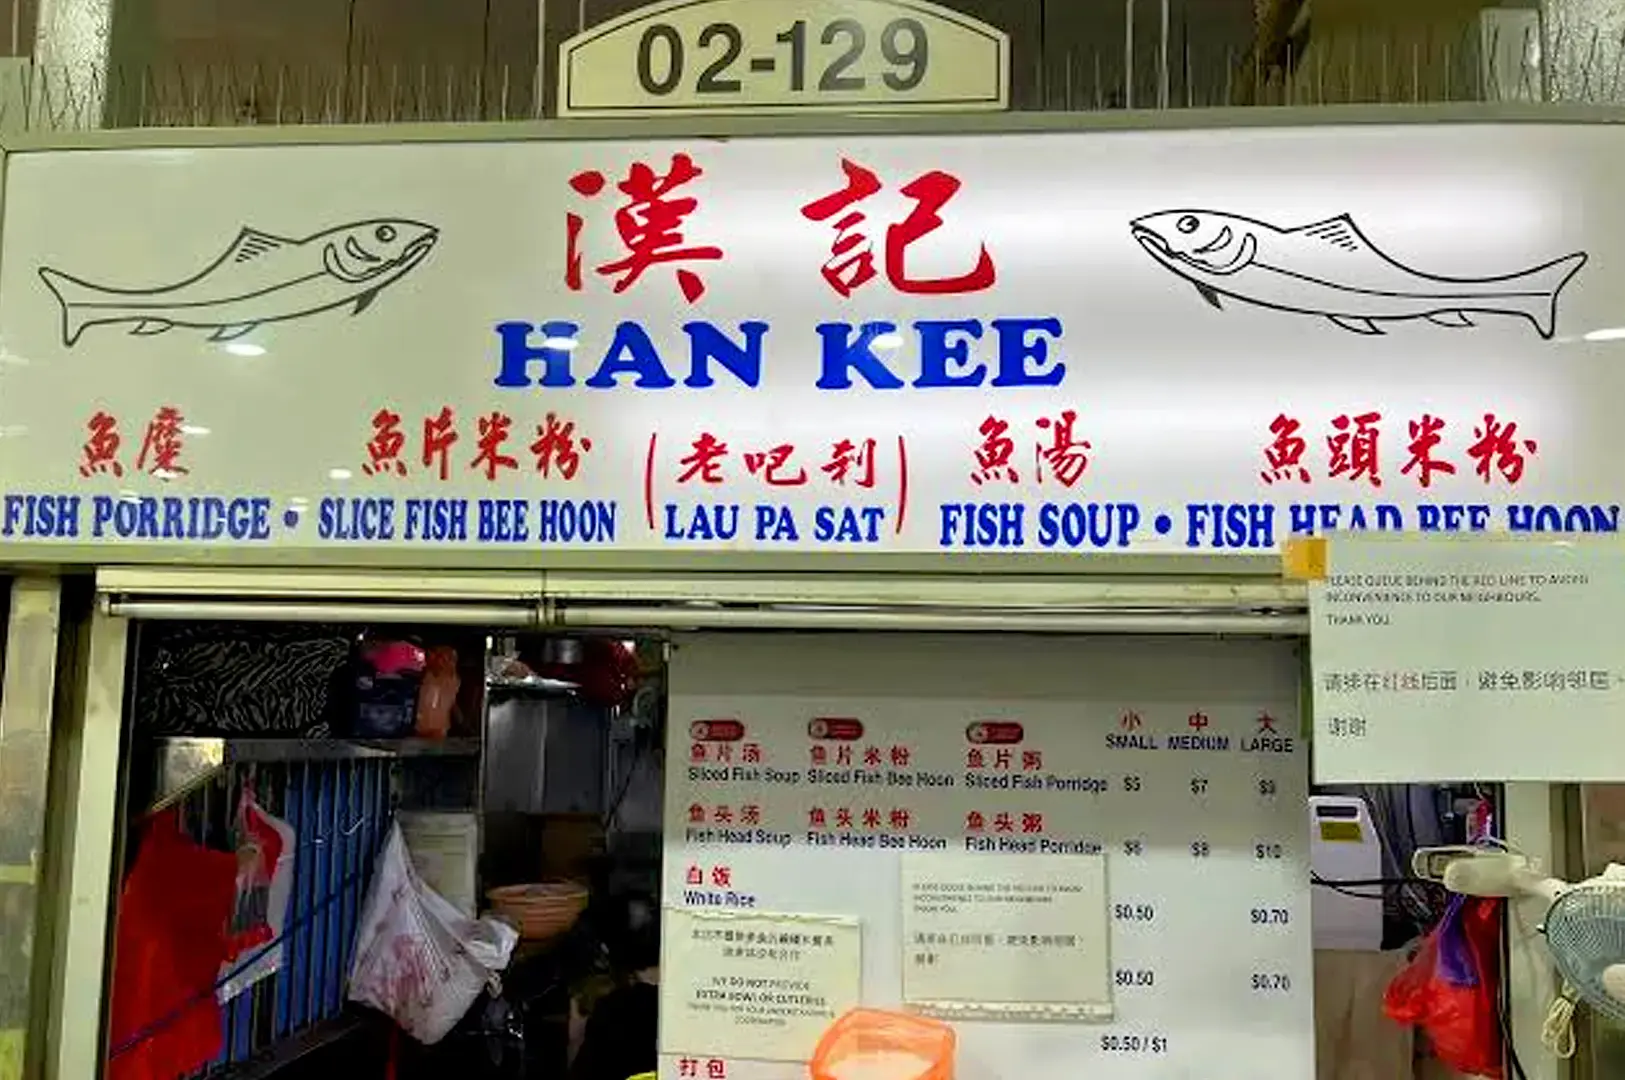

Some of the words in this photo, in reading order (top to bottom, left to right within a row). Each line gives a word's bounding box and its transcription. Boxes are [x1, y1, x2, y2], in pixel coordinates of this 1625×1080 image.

[636, 19, 930, 97] 02-129
[566, 152, 996, 303] 漢記
[493, 319, 770, 389] HAN
[815, 317, 1067, 390] KEE
[361, 407, 592, 481] 魚片米粉
[969, 410, 1091, 487] 魚湯
[1259, 413, 1537, 487] 魚頭米粉
[3, 495, 79, 540] FISH
[92, 496, 271, 540] PORRIDGE
[318, 500, 394, 542] SLICE
[403, 501, 469, 542] FISH
[479, 502, 530, 542] BEE
[538, 502, 617, 543] HOON
[664, 505, 740, 540] LAU
[755, 506, 799, 541] PA
[814, 506, 885, 542] SAT
[940, 503, 1025, 547] FISH
[1039, 503, 1140, 547] SOUP
[1185, 504, 1274, 547] FISH
[1289, 505, 1404, 534] HEAD
[1120, 711, 1142, 731] 小
[1187, 710, 1209, 731] 中
[1256, 713, 1277, 733] 大
[1106, 735, 1158, 750] SMALL
[1168, 736, 1230, 751] MEDIUM
[1240, 737, 1294, 753] LARGE
[916, 773, 955, 787] Hoon
[965, 774, 1009, 789] Sliced
[1012, 775, 1043, 790] Fish
[965, 837, 995, 852] Fish
[1115, 904, 1153, 921] $0.50
[1250, 907, 1289, 925] $0.70
[1115, 970, 1154, 987] $0.50
[1100, 1035, 1139, 1052] $0.50
[1151, 1036, 1168, 1053] $1
[679, 1058, 726, 1079] 打包
